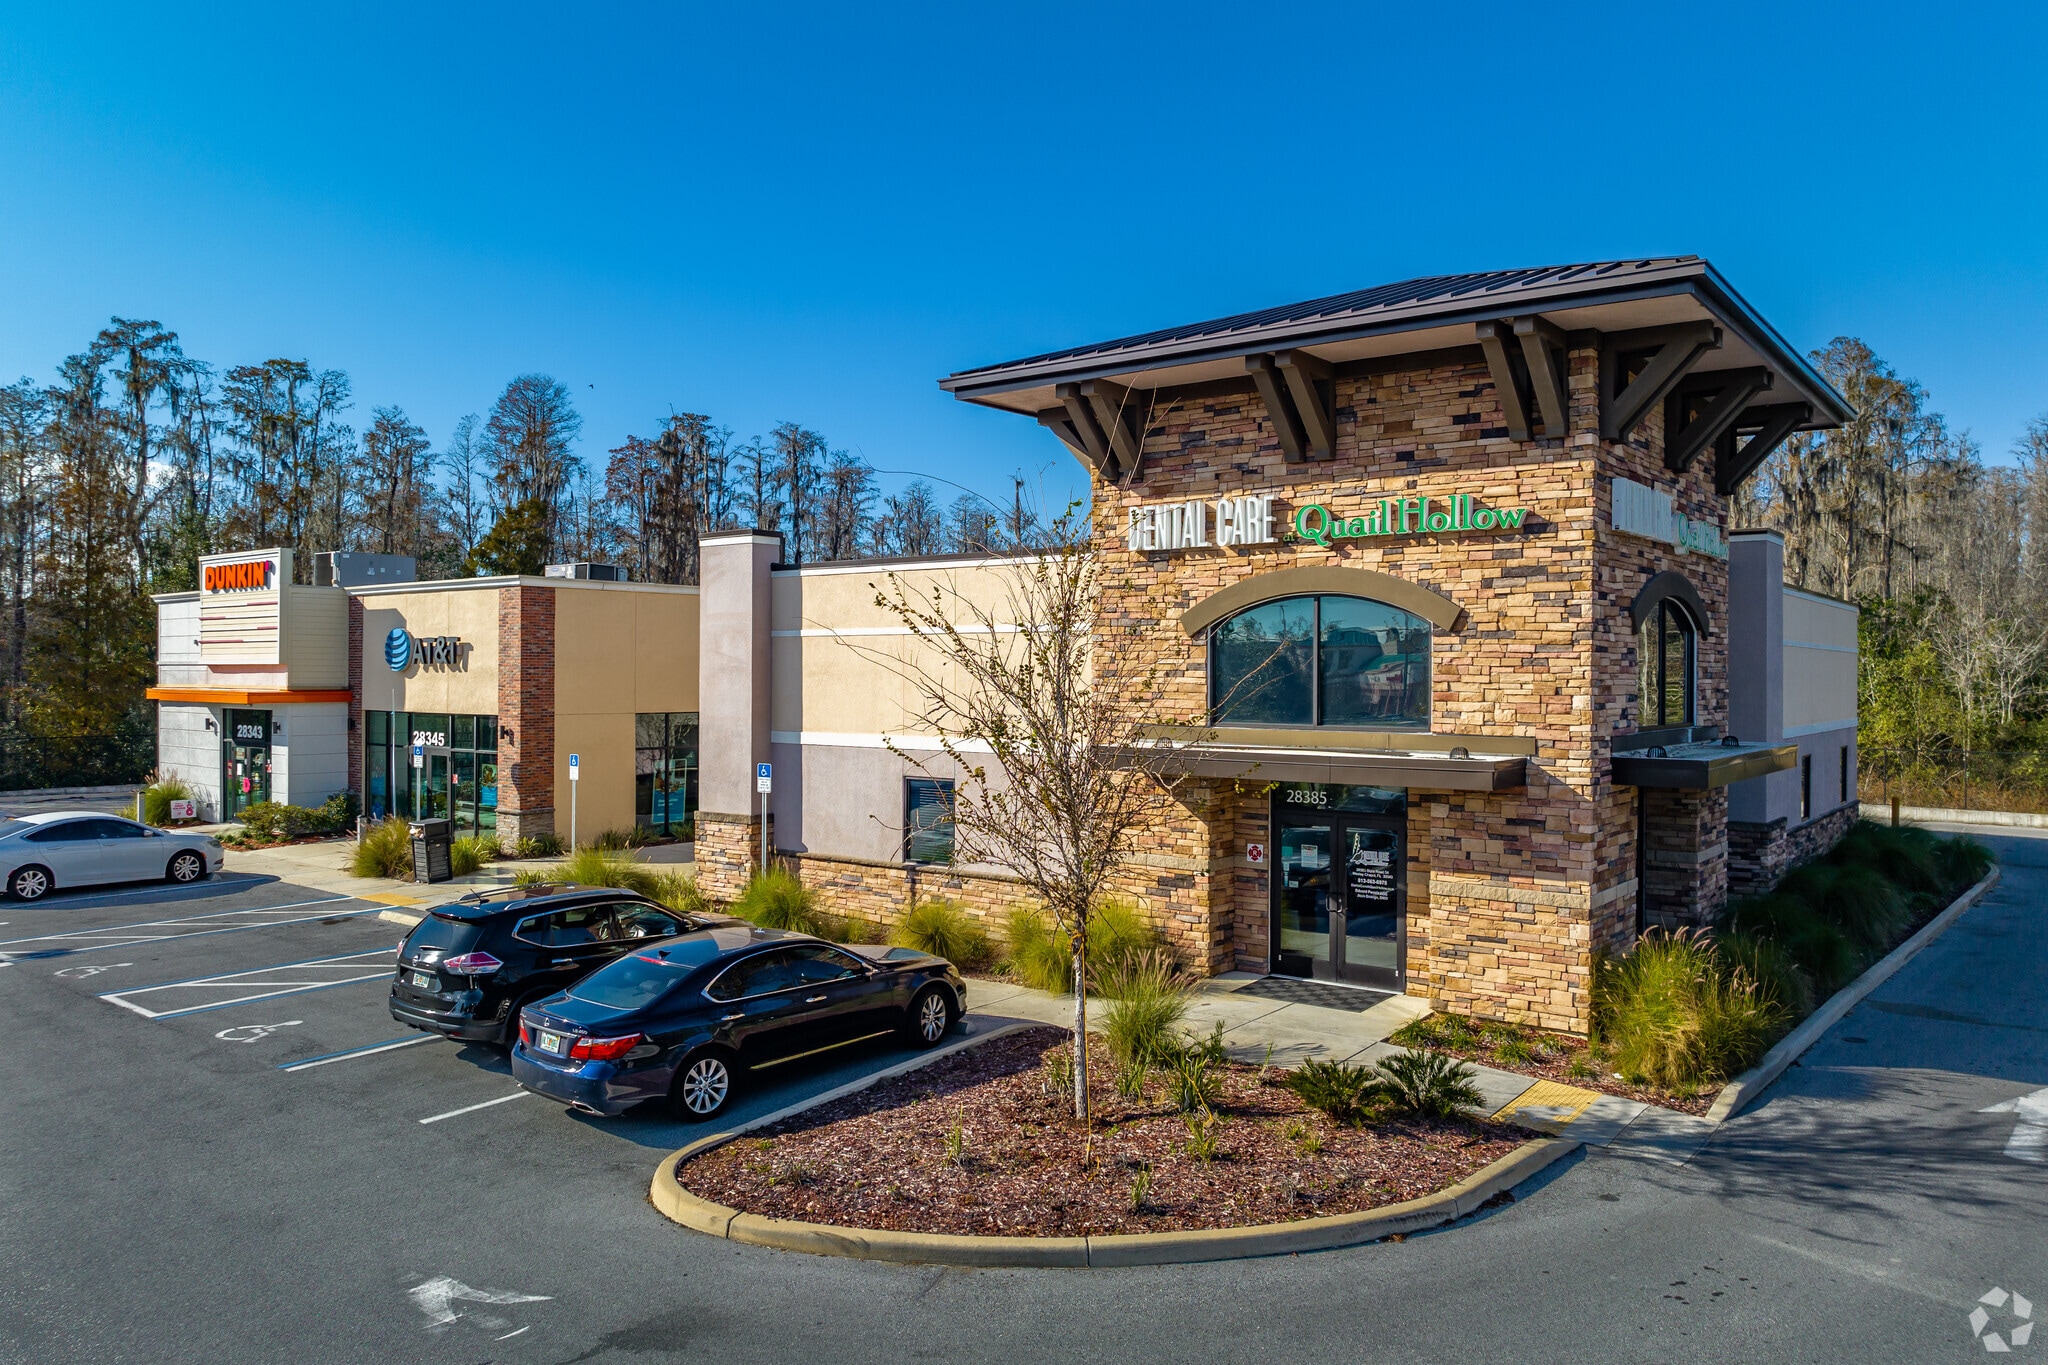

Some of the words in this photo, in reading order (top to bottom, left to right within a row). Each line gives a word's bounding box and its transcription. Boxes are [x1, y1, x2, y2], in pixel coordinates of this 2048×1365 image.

[1128, 501, 1212, 551] DENTAL
[1216, 495, 1278, 547] CARE
[1283, 534, 1295, 542] at
[1295, 499, 1392, 547] Quail
[1396, 493, 1526, 535] Hollow
[205, 560, 269, 590] DUNKIN'
[412, 636, 461, 665] AT&T
[237, 725, 263, 739] 28343
[413, 731, 445, 746] 28345
[1287, 790, 1327, 804] 28385
